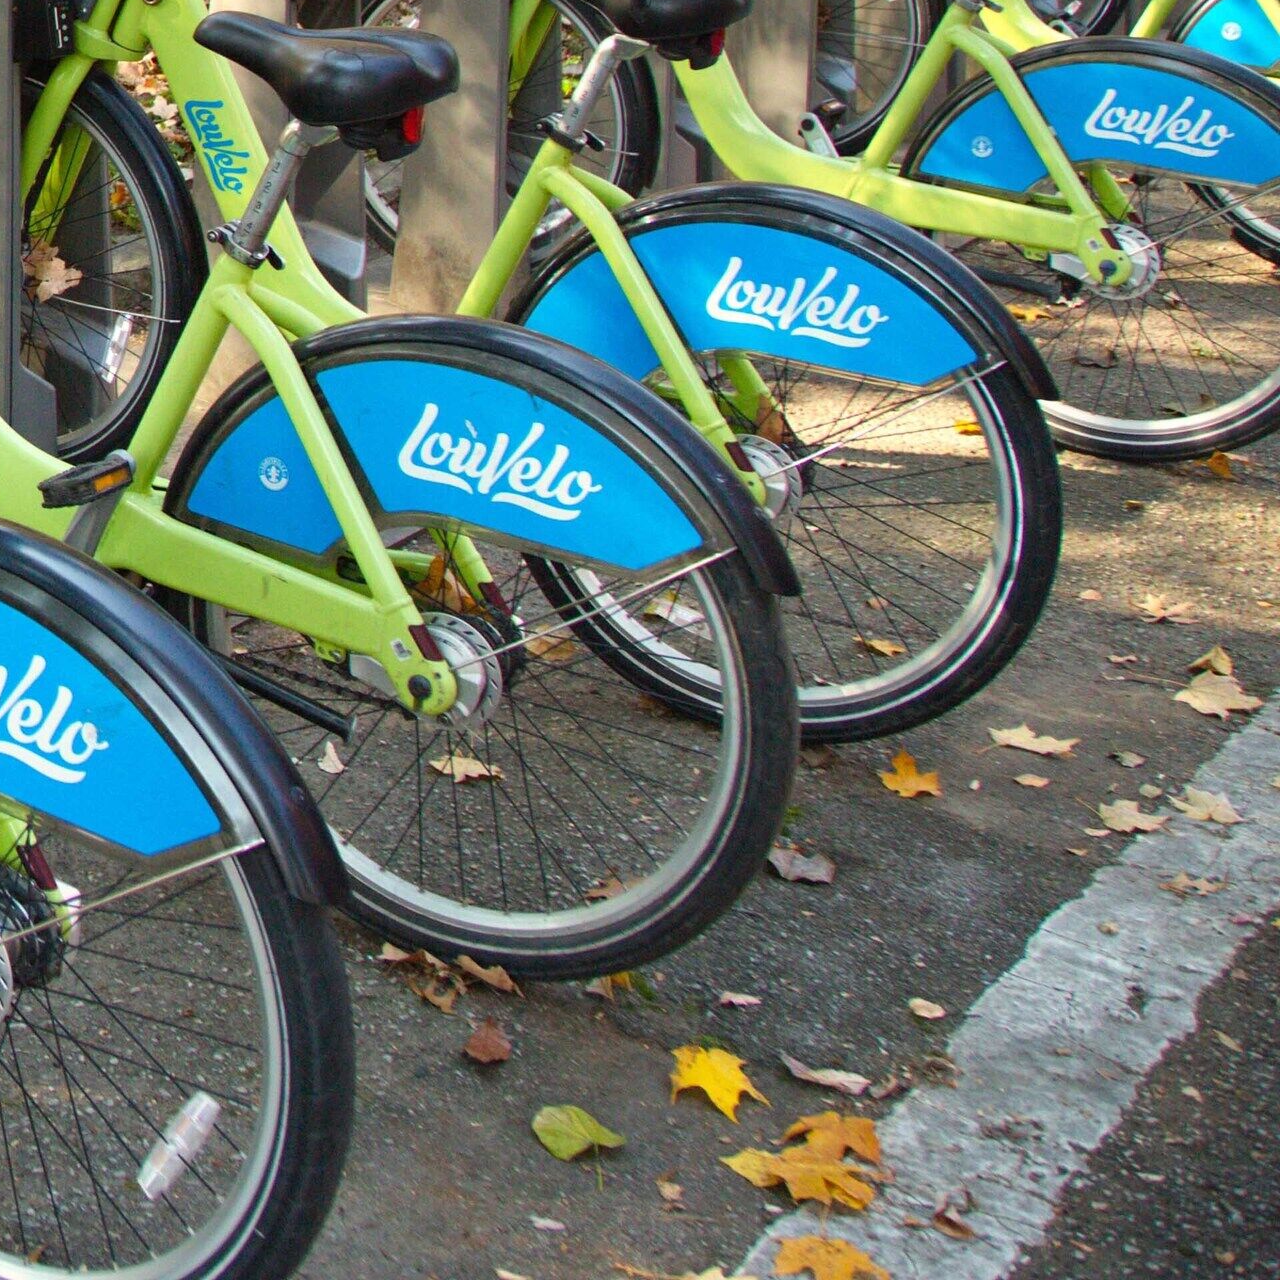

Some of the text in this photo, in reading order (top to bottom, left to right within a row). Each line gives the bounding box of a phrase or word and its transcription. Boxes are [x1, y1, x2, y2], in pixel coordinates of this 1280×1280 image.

[184, 100, 251, 195] LouVelo
[1085, 88, 1236, 158] LouVelo
[706, 256, 889, 348] LouVelo
[398, 403, 602, 521] LouVelo
